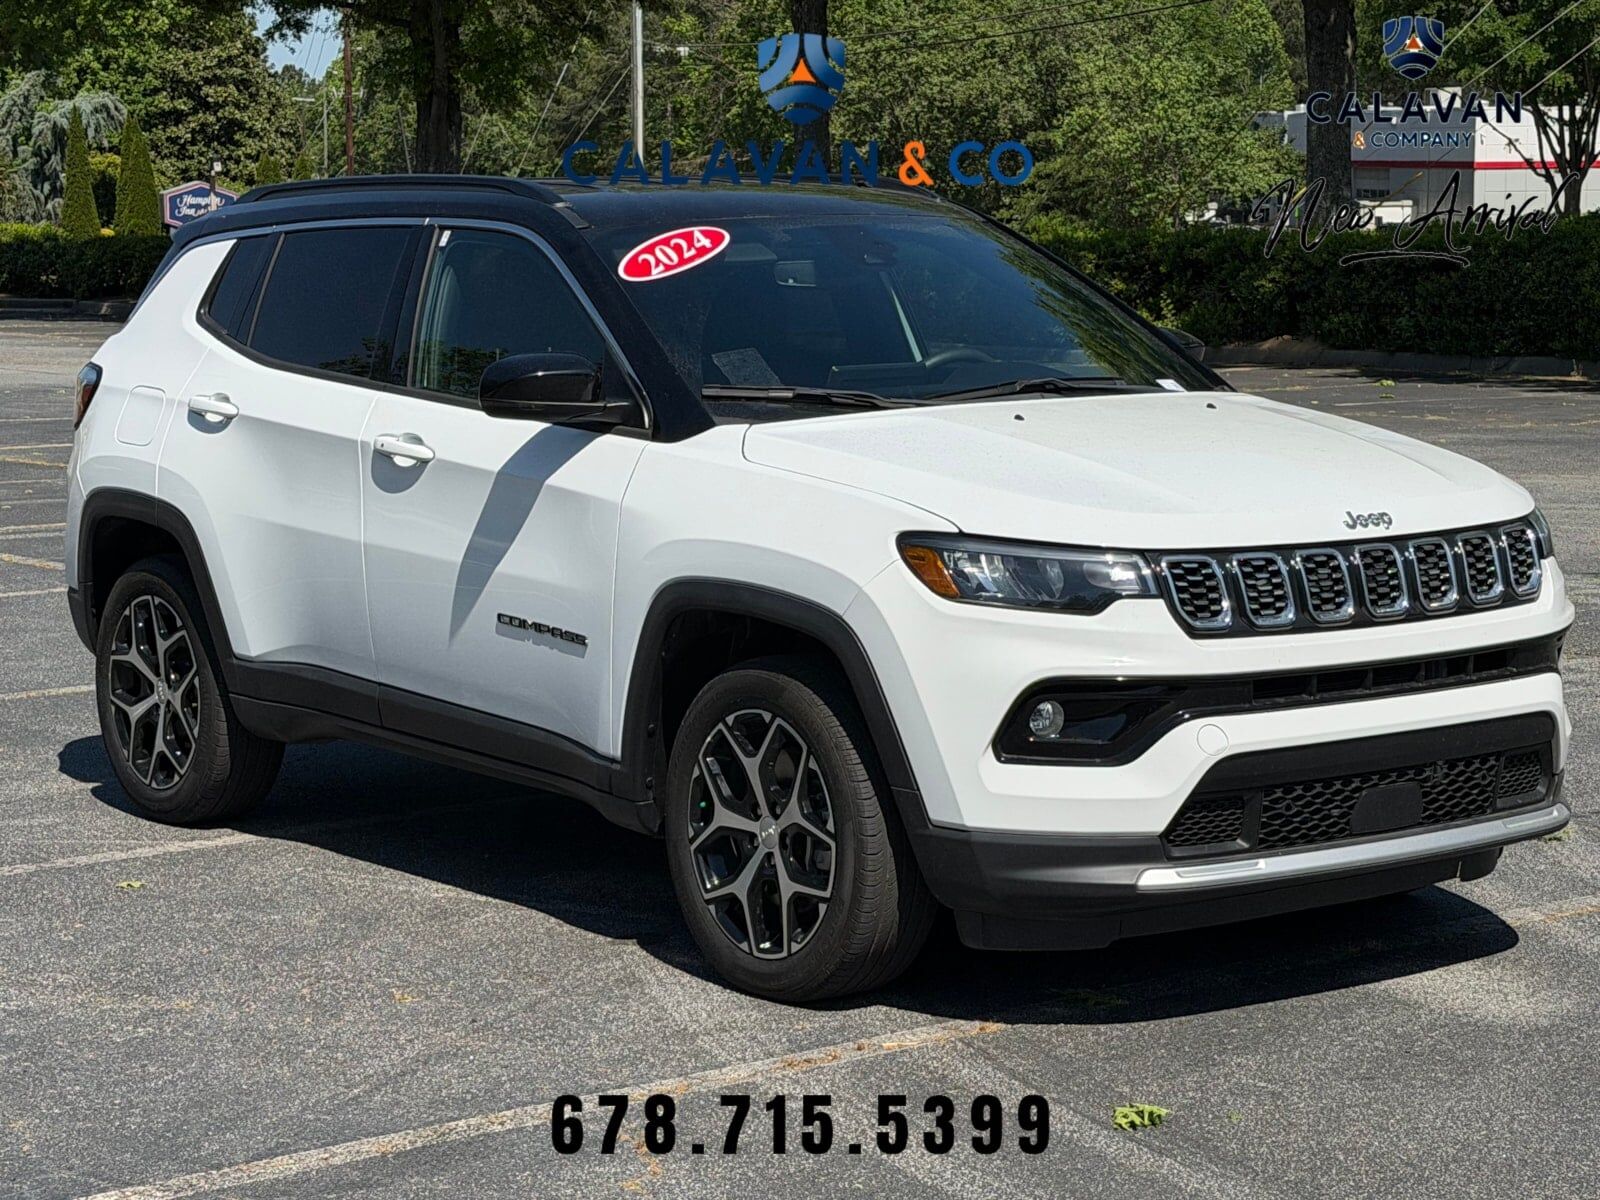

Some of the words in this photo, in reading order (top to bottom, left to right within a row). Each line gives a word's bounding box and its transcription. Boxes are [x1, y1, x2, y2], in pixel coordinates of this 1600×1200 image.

[637, 229, 713, 276] 2024
[1343, 510, 1393, 530] Jeep
[497, 612, 588, 646] COMPASS
